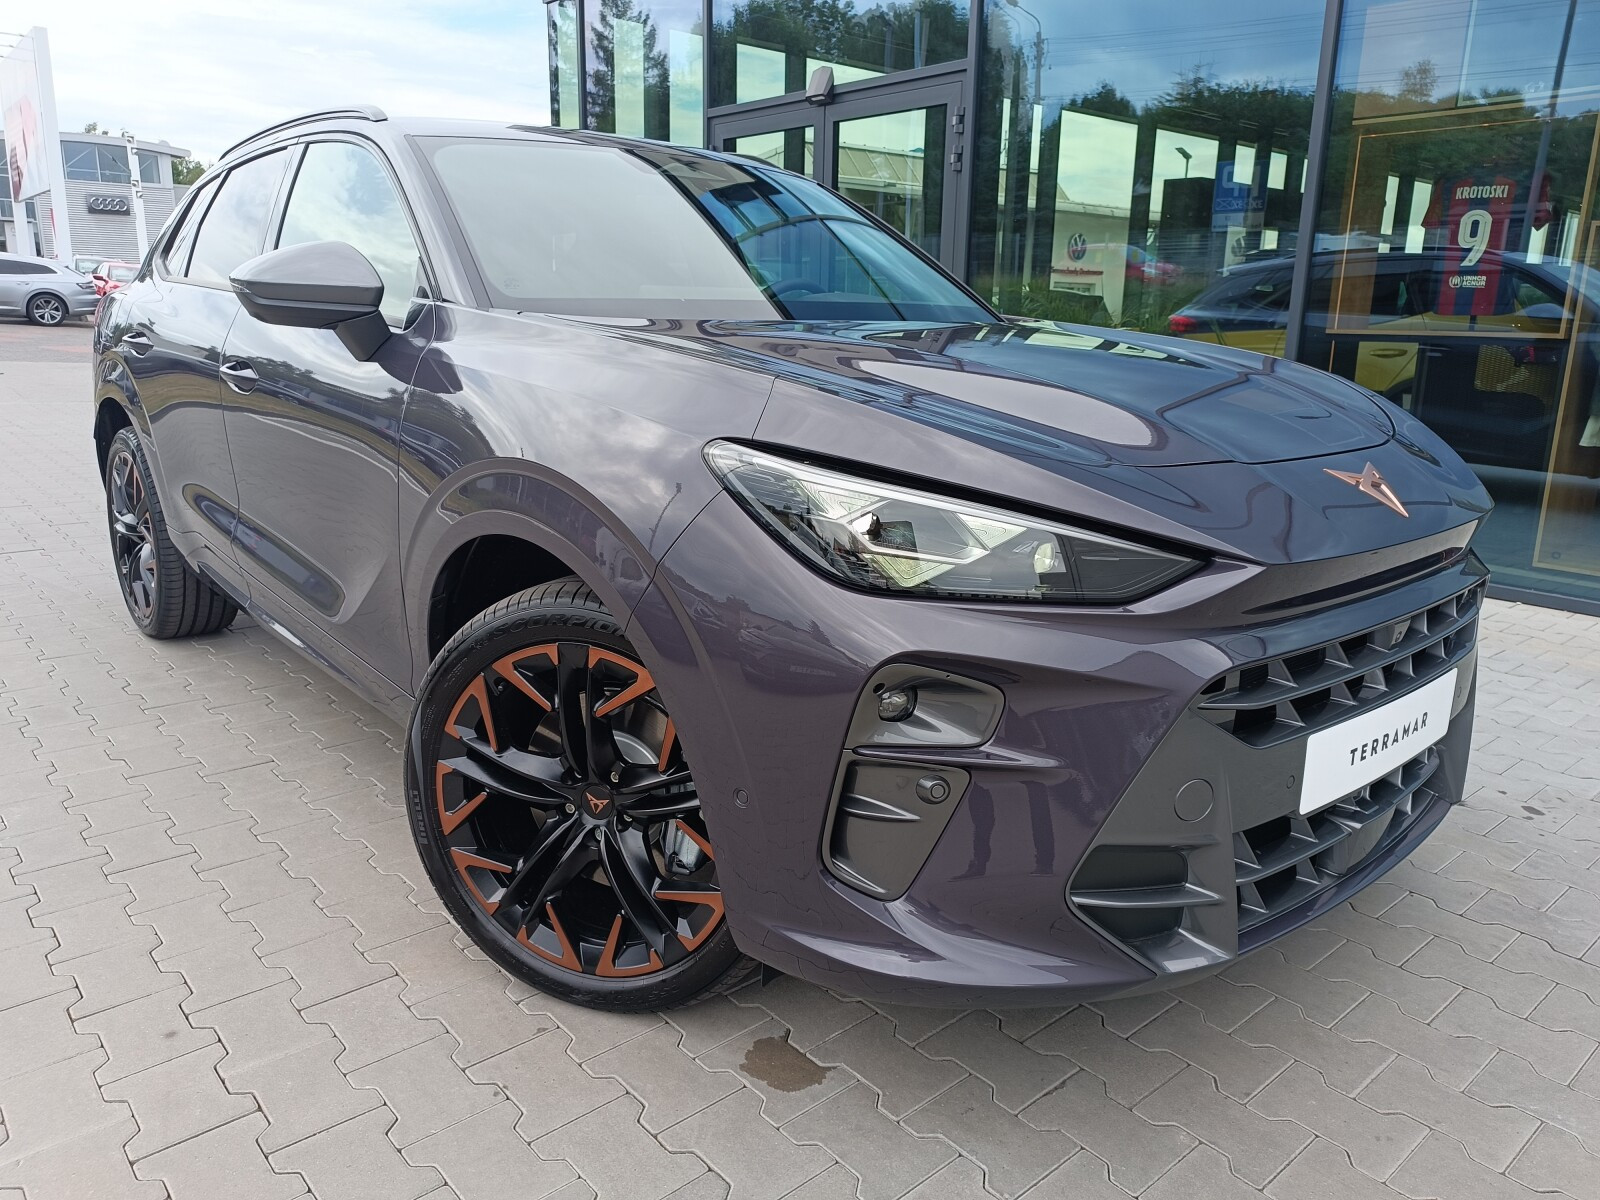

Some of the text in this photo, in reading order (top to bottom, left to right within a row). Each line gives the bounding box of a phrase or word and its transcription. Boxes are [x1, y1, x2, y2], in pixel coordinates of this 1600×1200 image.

[1455, 185, 1509, 199] KROTOSKI
[1457, 209, 1493, 267] 9
[1350, 711, 1428, 766] TERRAMAR
[409, 789, 429, 845] PIRELLI
